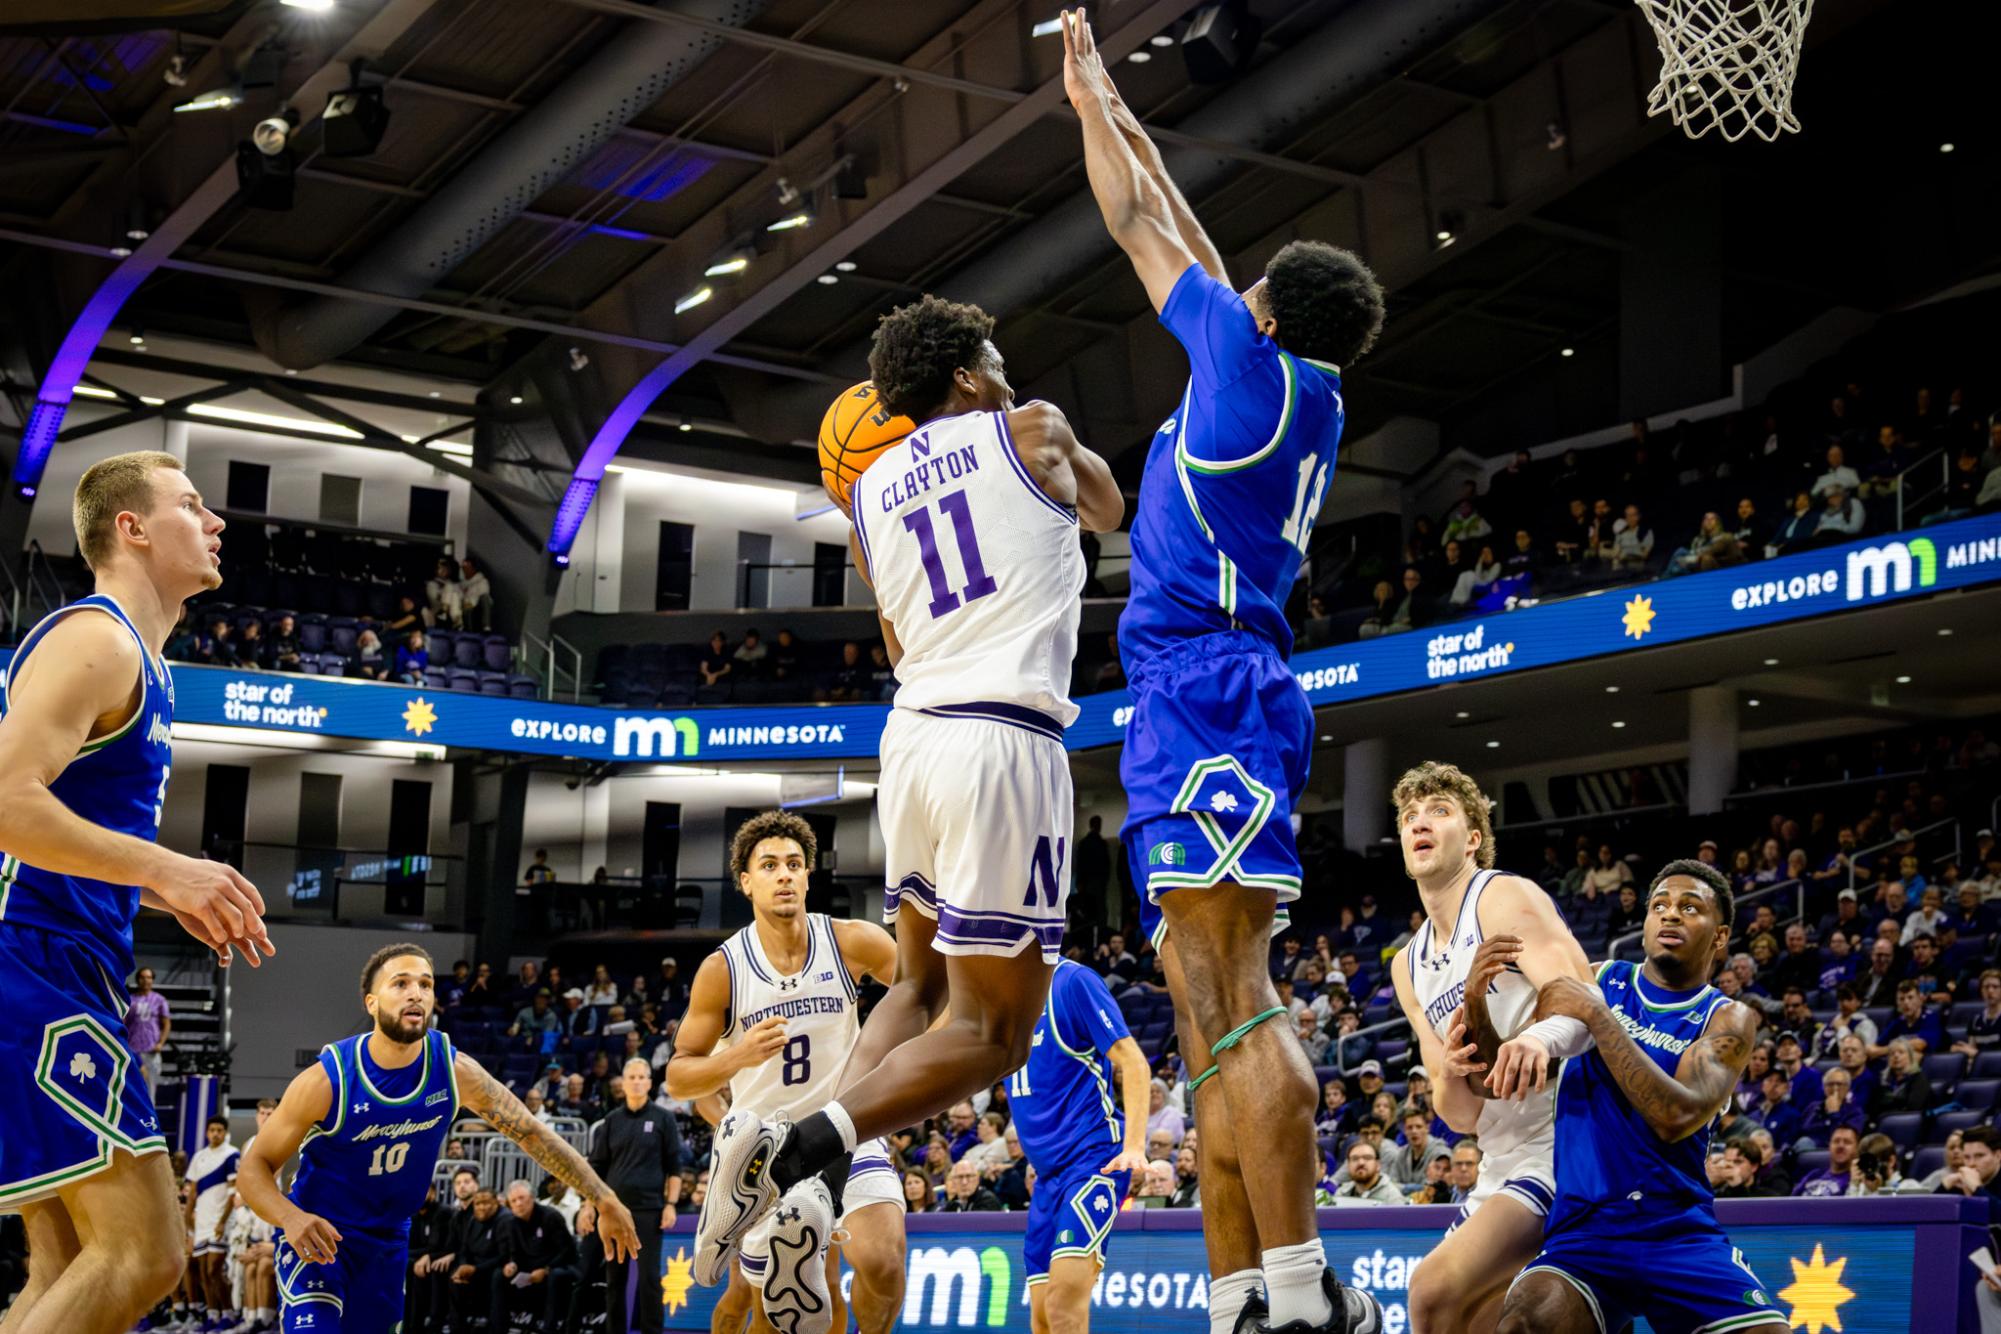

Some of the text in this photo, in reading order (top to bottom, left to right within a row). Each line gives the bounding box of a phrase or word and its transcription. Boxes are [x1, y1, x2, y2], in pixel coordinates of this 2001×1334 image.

[910, 431, 931, 463] N
[882, 445, 979, 513] CLAYTON
[902, 489, 998, 620] 11
[1946, 535, 2001, 569] MIN
[1427, 624, 1484, 658] star of
[1427, 643, 1510, 679] the north
[225, 681, 294, 705] star of
[224, 699, 321, 728] the north
[1023, 834, 1065, 908] N
[782, 1034, 811, 1086] 8
[368, 1142, 411, 1176] 10
[1351, 1249, 1423, 1291] star
